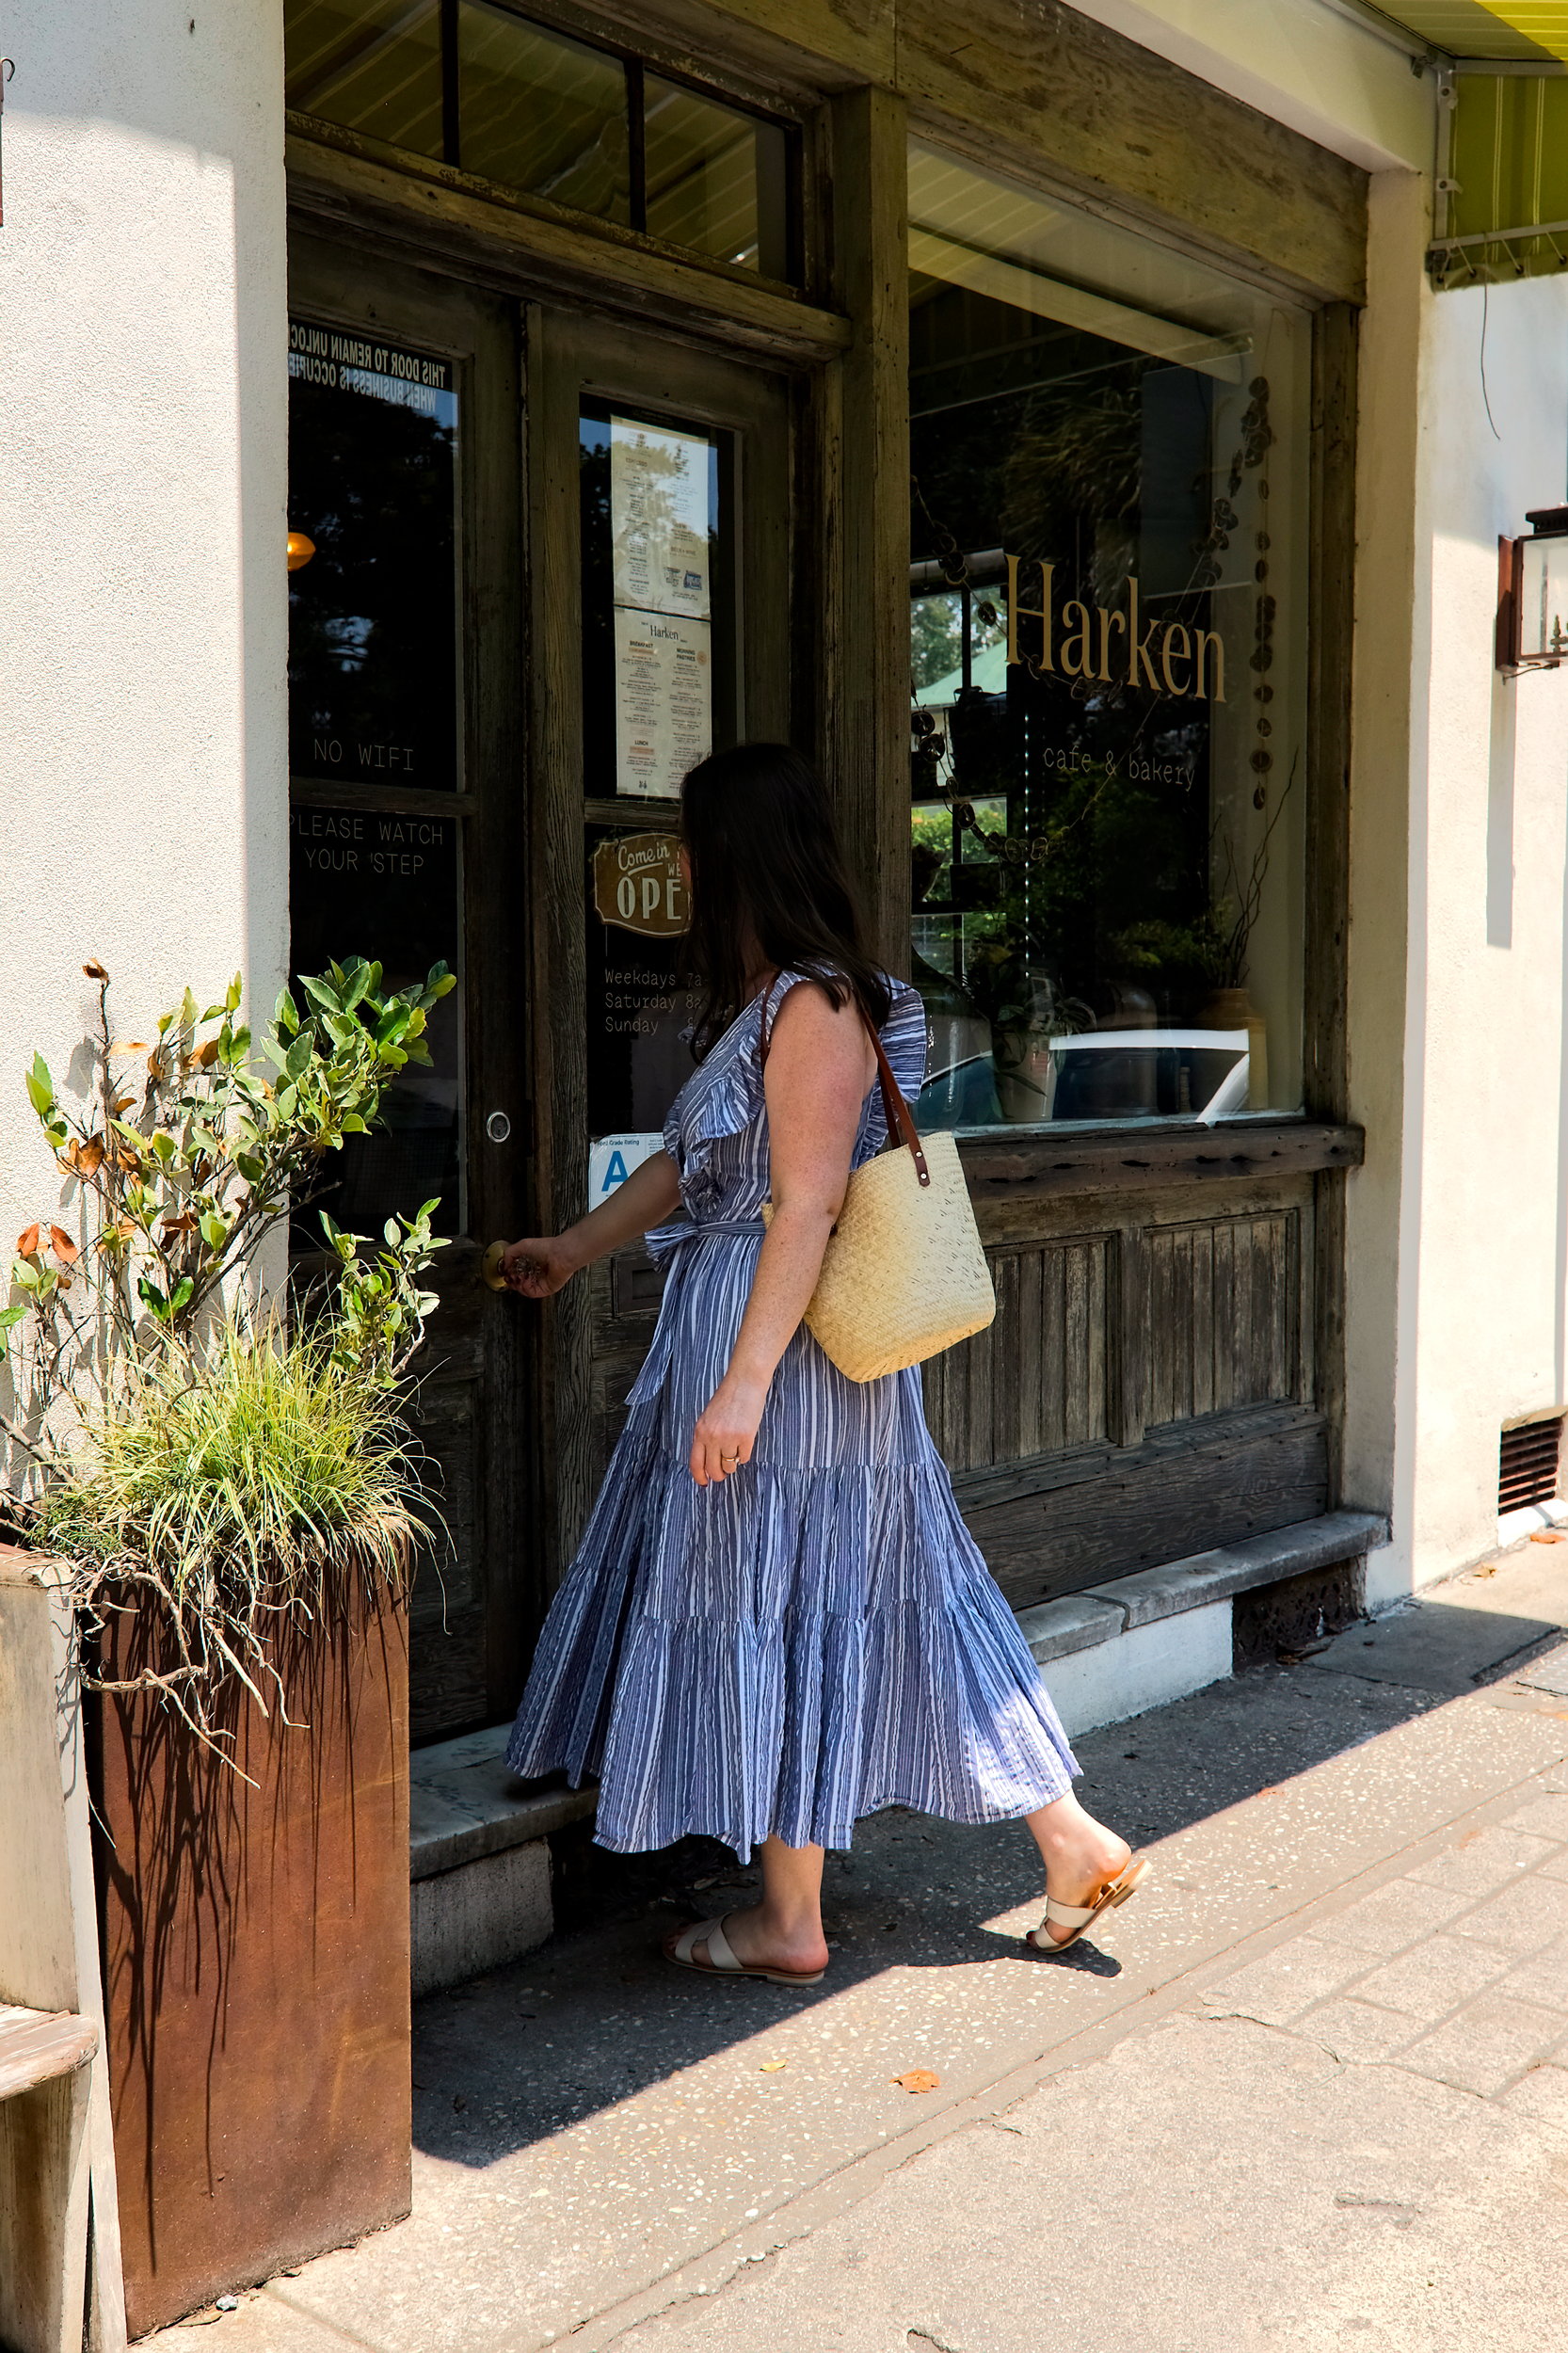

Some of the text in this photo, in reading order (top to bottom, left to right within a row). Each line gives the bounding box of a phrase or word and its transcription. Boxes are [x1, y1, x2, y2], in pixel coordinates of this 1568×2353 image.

[649, 625, 679, 640] Harken
[1003, 552, 1227, 703] Harken
[314, 738, 414, 771] NO WIFI
[1043, 744, 1195, 792] cafe & bakery
[378, 820, 443, 845] WATCH
[304, 847, 424, 875] YOUR STEP
[617, 841, 670, 872] Come in
[616, 876, 681, 920] OPE
[604, 968, 676, 989] Weekdays
[604, 992, 677, 1014] Saturday
[604, 1016, 659, 1036] Sunday
[601, 1150, 629, 1192] A
